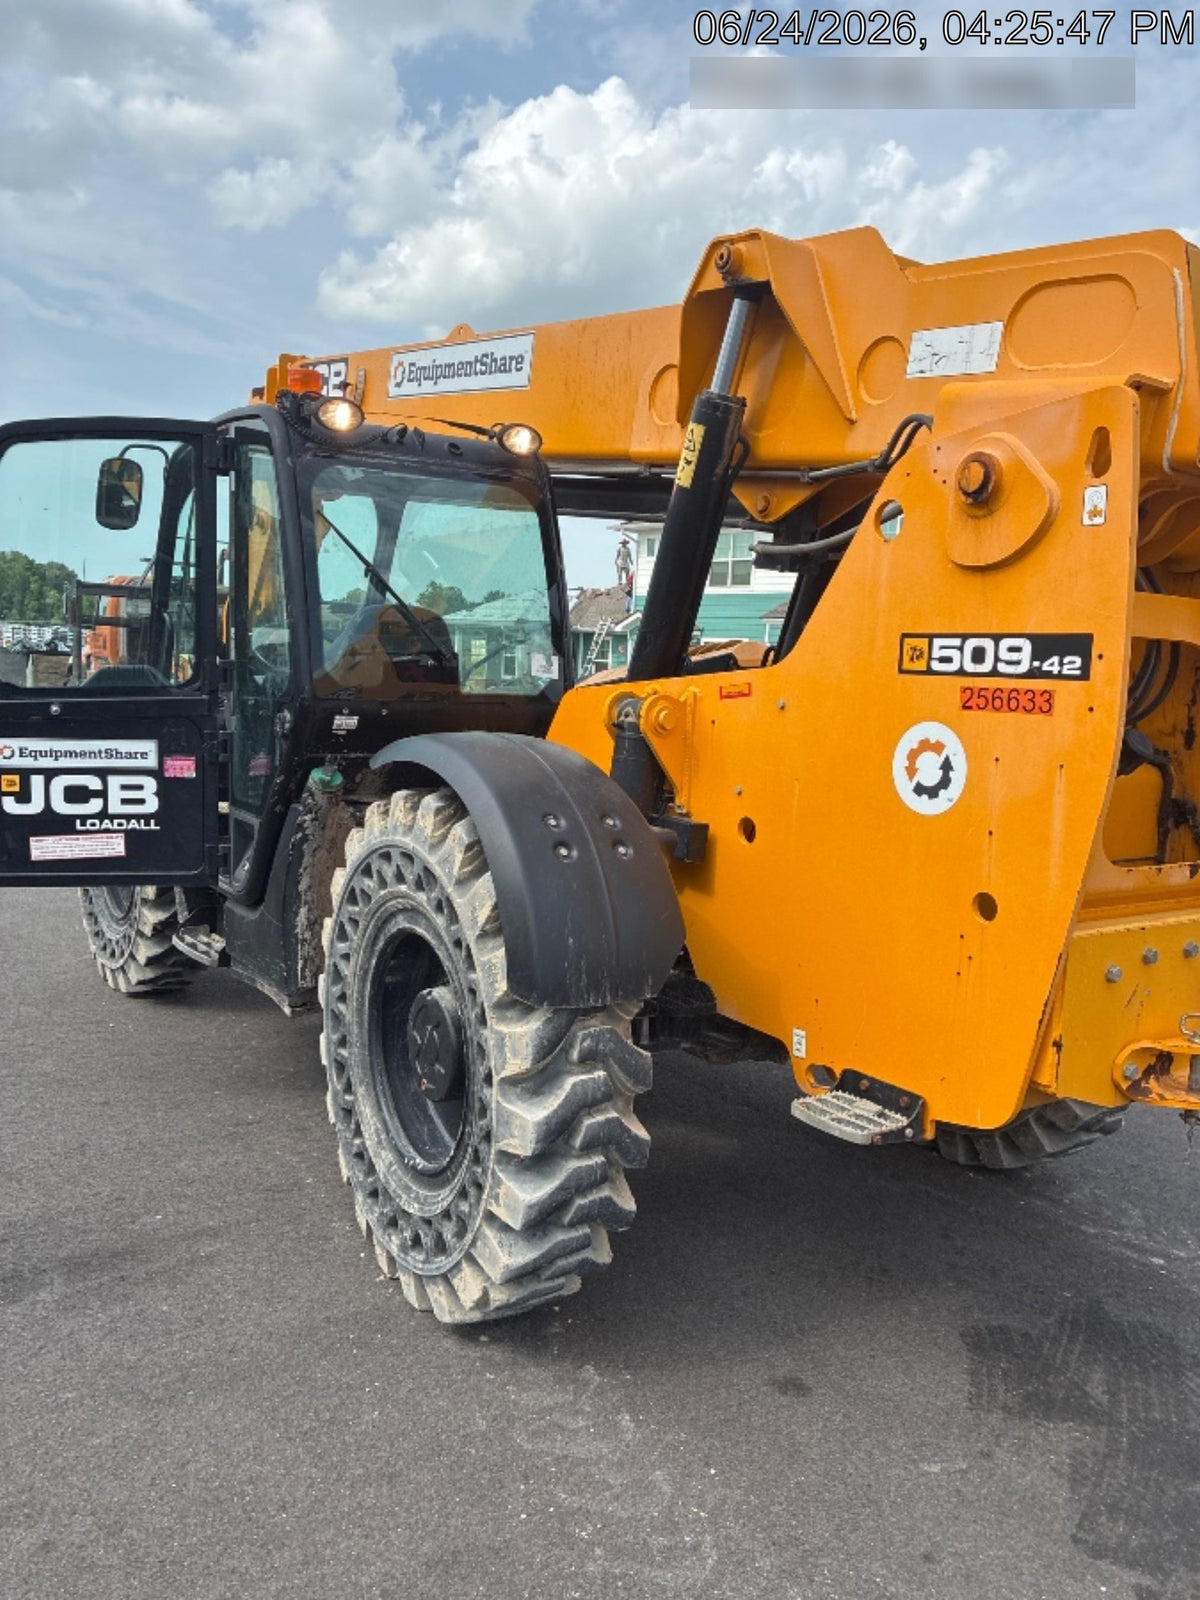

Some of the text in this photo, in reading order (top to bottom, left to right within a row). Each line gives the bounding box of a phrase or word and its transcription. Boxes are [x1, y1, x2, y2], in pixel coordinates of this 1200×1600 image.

[406, 352, 525, 387] EquipmentShare
[930, 637, 1082, 675] 509-42
[961, 687, 1053, 714] 256633
[19, 747, 149, 761] EquipmentShare
[1, 774, 159, 815] JCB
[76, 819, 160, 830] LOADALL
